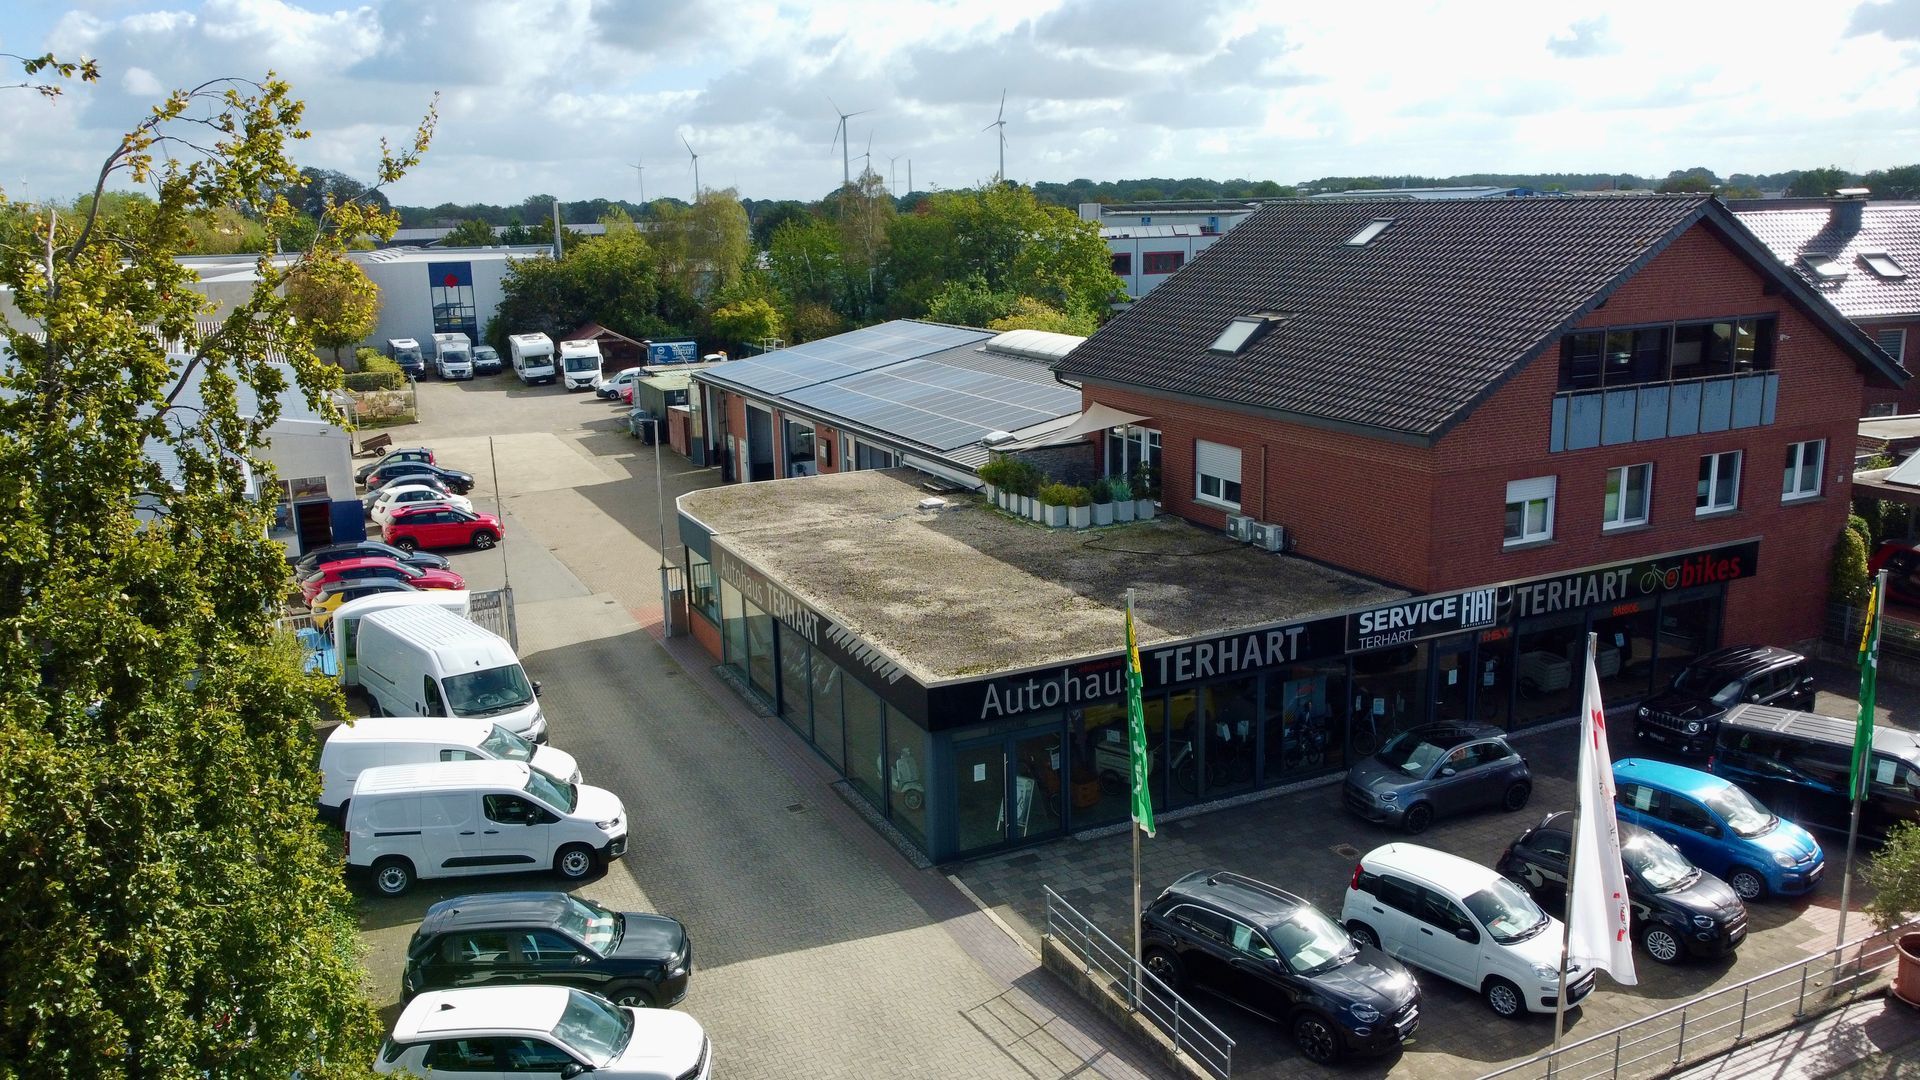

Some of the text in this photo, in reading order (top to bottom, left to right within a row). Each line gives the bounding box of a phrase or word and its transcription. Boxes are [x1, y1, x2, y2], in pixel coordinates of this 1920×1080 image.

[721, 552, 819, 646] Autohaus TERHART
[1358, 588, 1495, 634] SERVICE FIAT
[1517, 567, 1633, 617] TERHART
[1154, 626, 1305, 685] TERHART
[1358, 628, 1414, 650] TERHART
